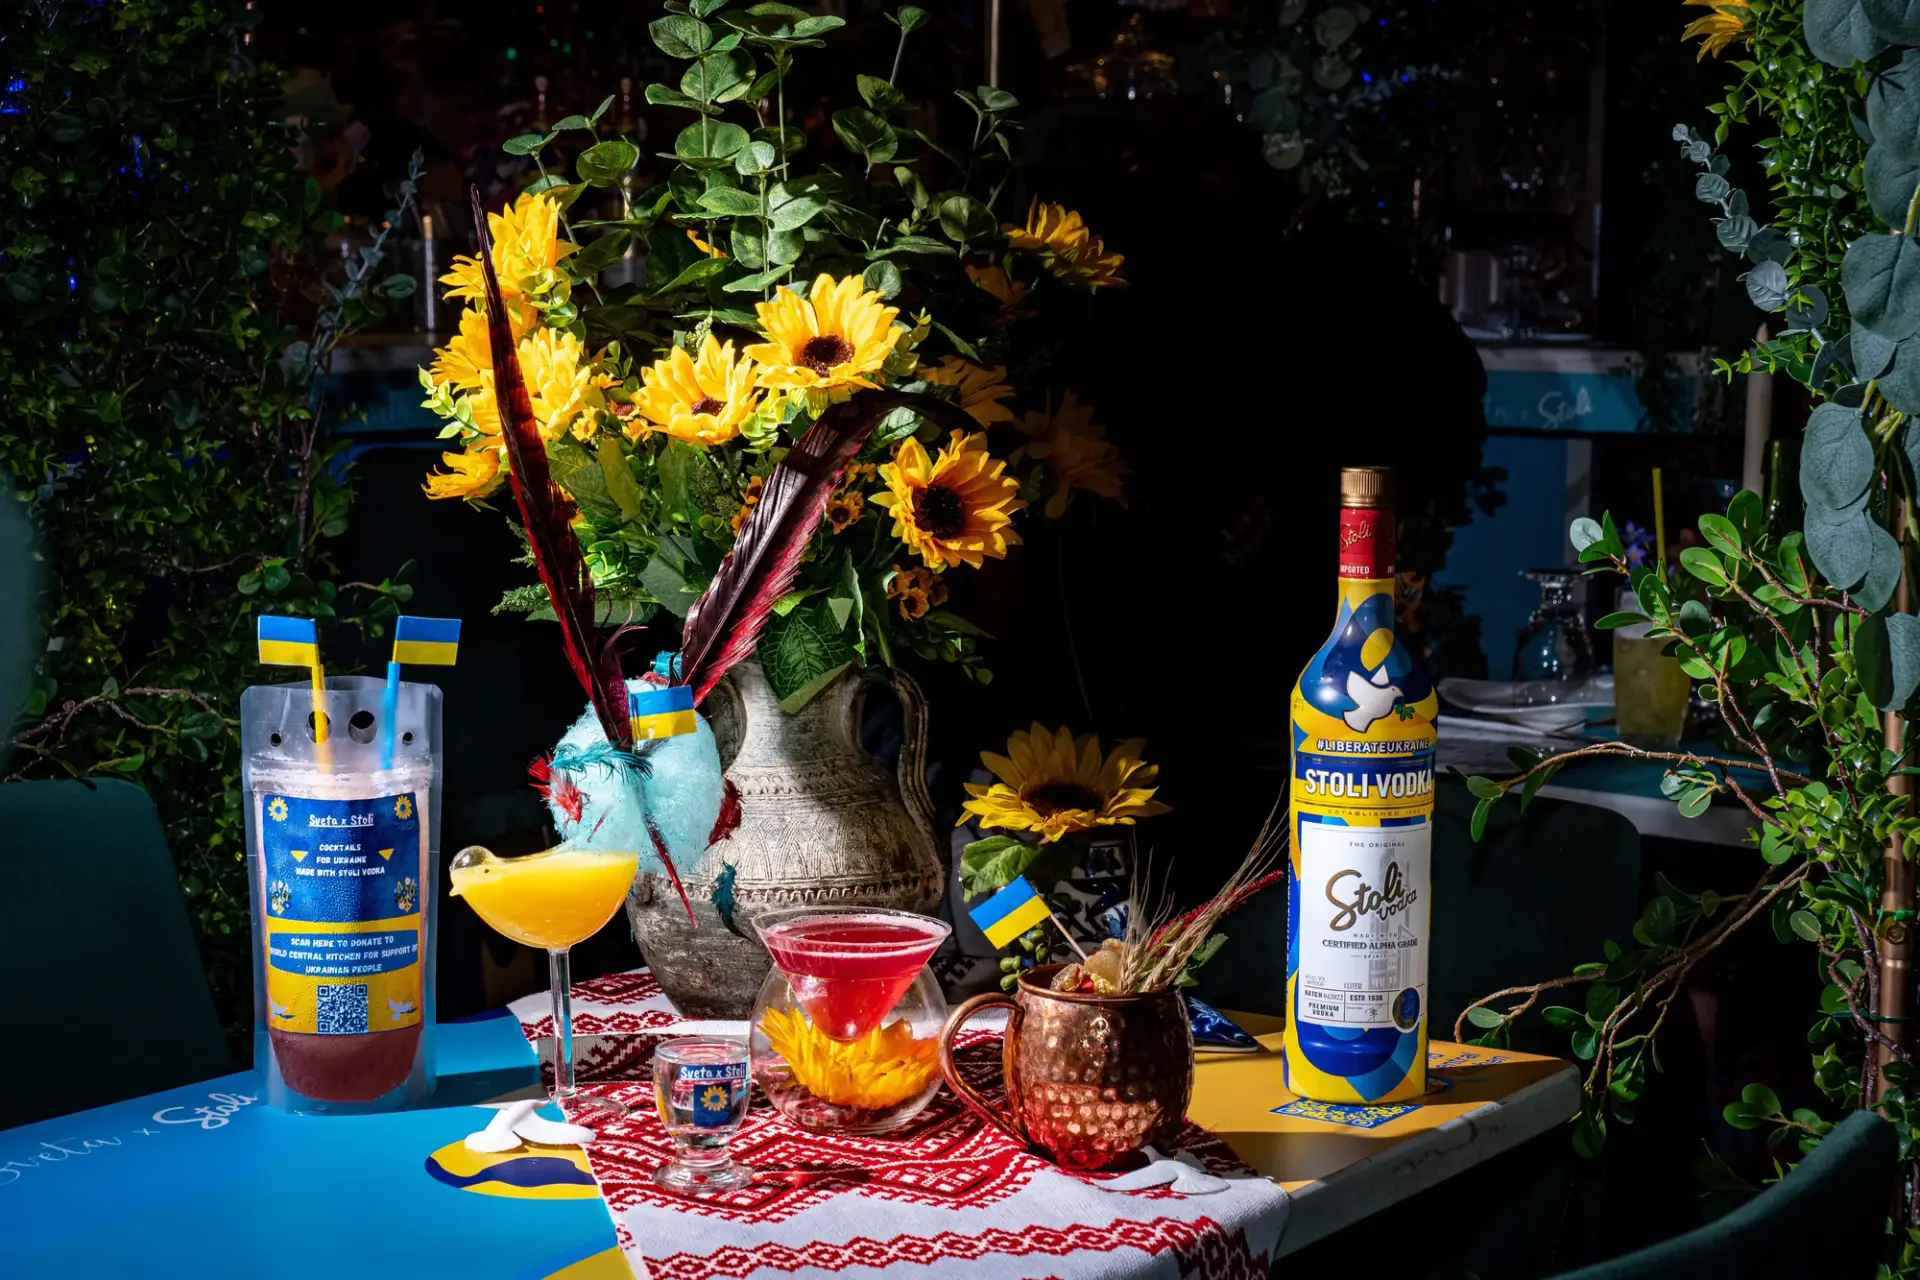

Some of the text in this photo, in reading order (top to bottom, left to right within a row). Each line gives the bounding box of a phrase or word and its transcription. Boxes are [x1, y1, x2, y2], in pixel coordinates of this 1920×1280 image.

[1340, 520, 1371, 553] Stoli
[1317, 738, 1430, 753] #LIBERATEUKRAINE
[1305, 768, 1432, 798] STOLI VODKA
[1328, 808, 1400, 816] ESTABLISHED
[309, 814, 338, 826] Sveta
[351, 813, 374, 825] Stoli
[319, 844, 361, 852] COCKTAILS
[316, 856, 367, 864] FOR UKRAINE
[296, 867, 385, 877] MADE WITH STOLI VODKA
[1325, 861, 1405, 931] Stoli
[1376, 889, 1418, 921] vodka
[291, 937, 311, 947] SCAN
[313, 939, 335, 948] HERE
[351, 937, 383, 947] DONATE
[385, 936, 394, 944] TO
[1322, 938, 1418, 950] CERTIFIED ALPHA GRADE
[289, 950, 323, 961] CENTRAL
[326, 952, 361, 961] KITCHEN
[364, 951, 379, 959] FOR
[381, 946, 410, 958] SUPPORT
[305, 964, 382, 974] UKRAINIAN PEOPLE
[1304, 990, 1323, 998] BATCH
[1308, 1002, 1340, 1012] PREMIUM
[1312, 1009, 1334, 1017] VODKA
[680, 1064, 745, 1078] Sveta x Stoli
[152, 1092, 259, 1130] Stoli
